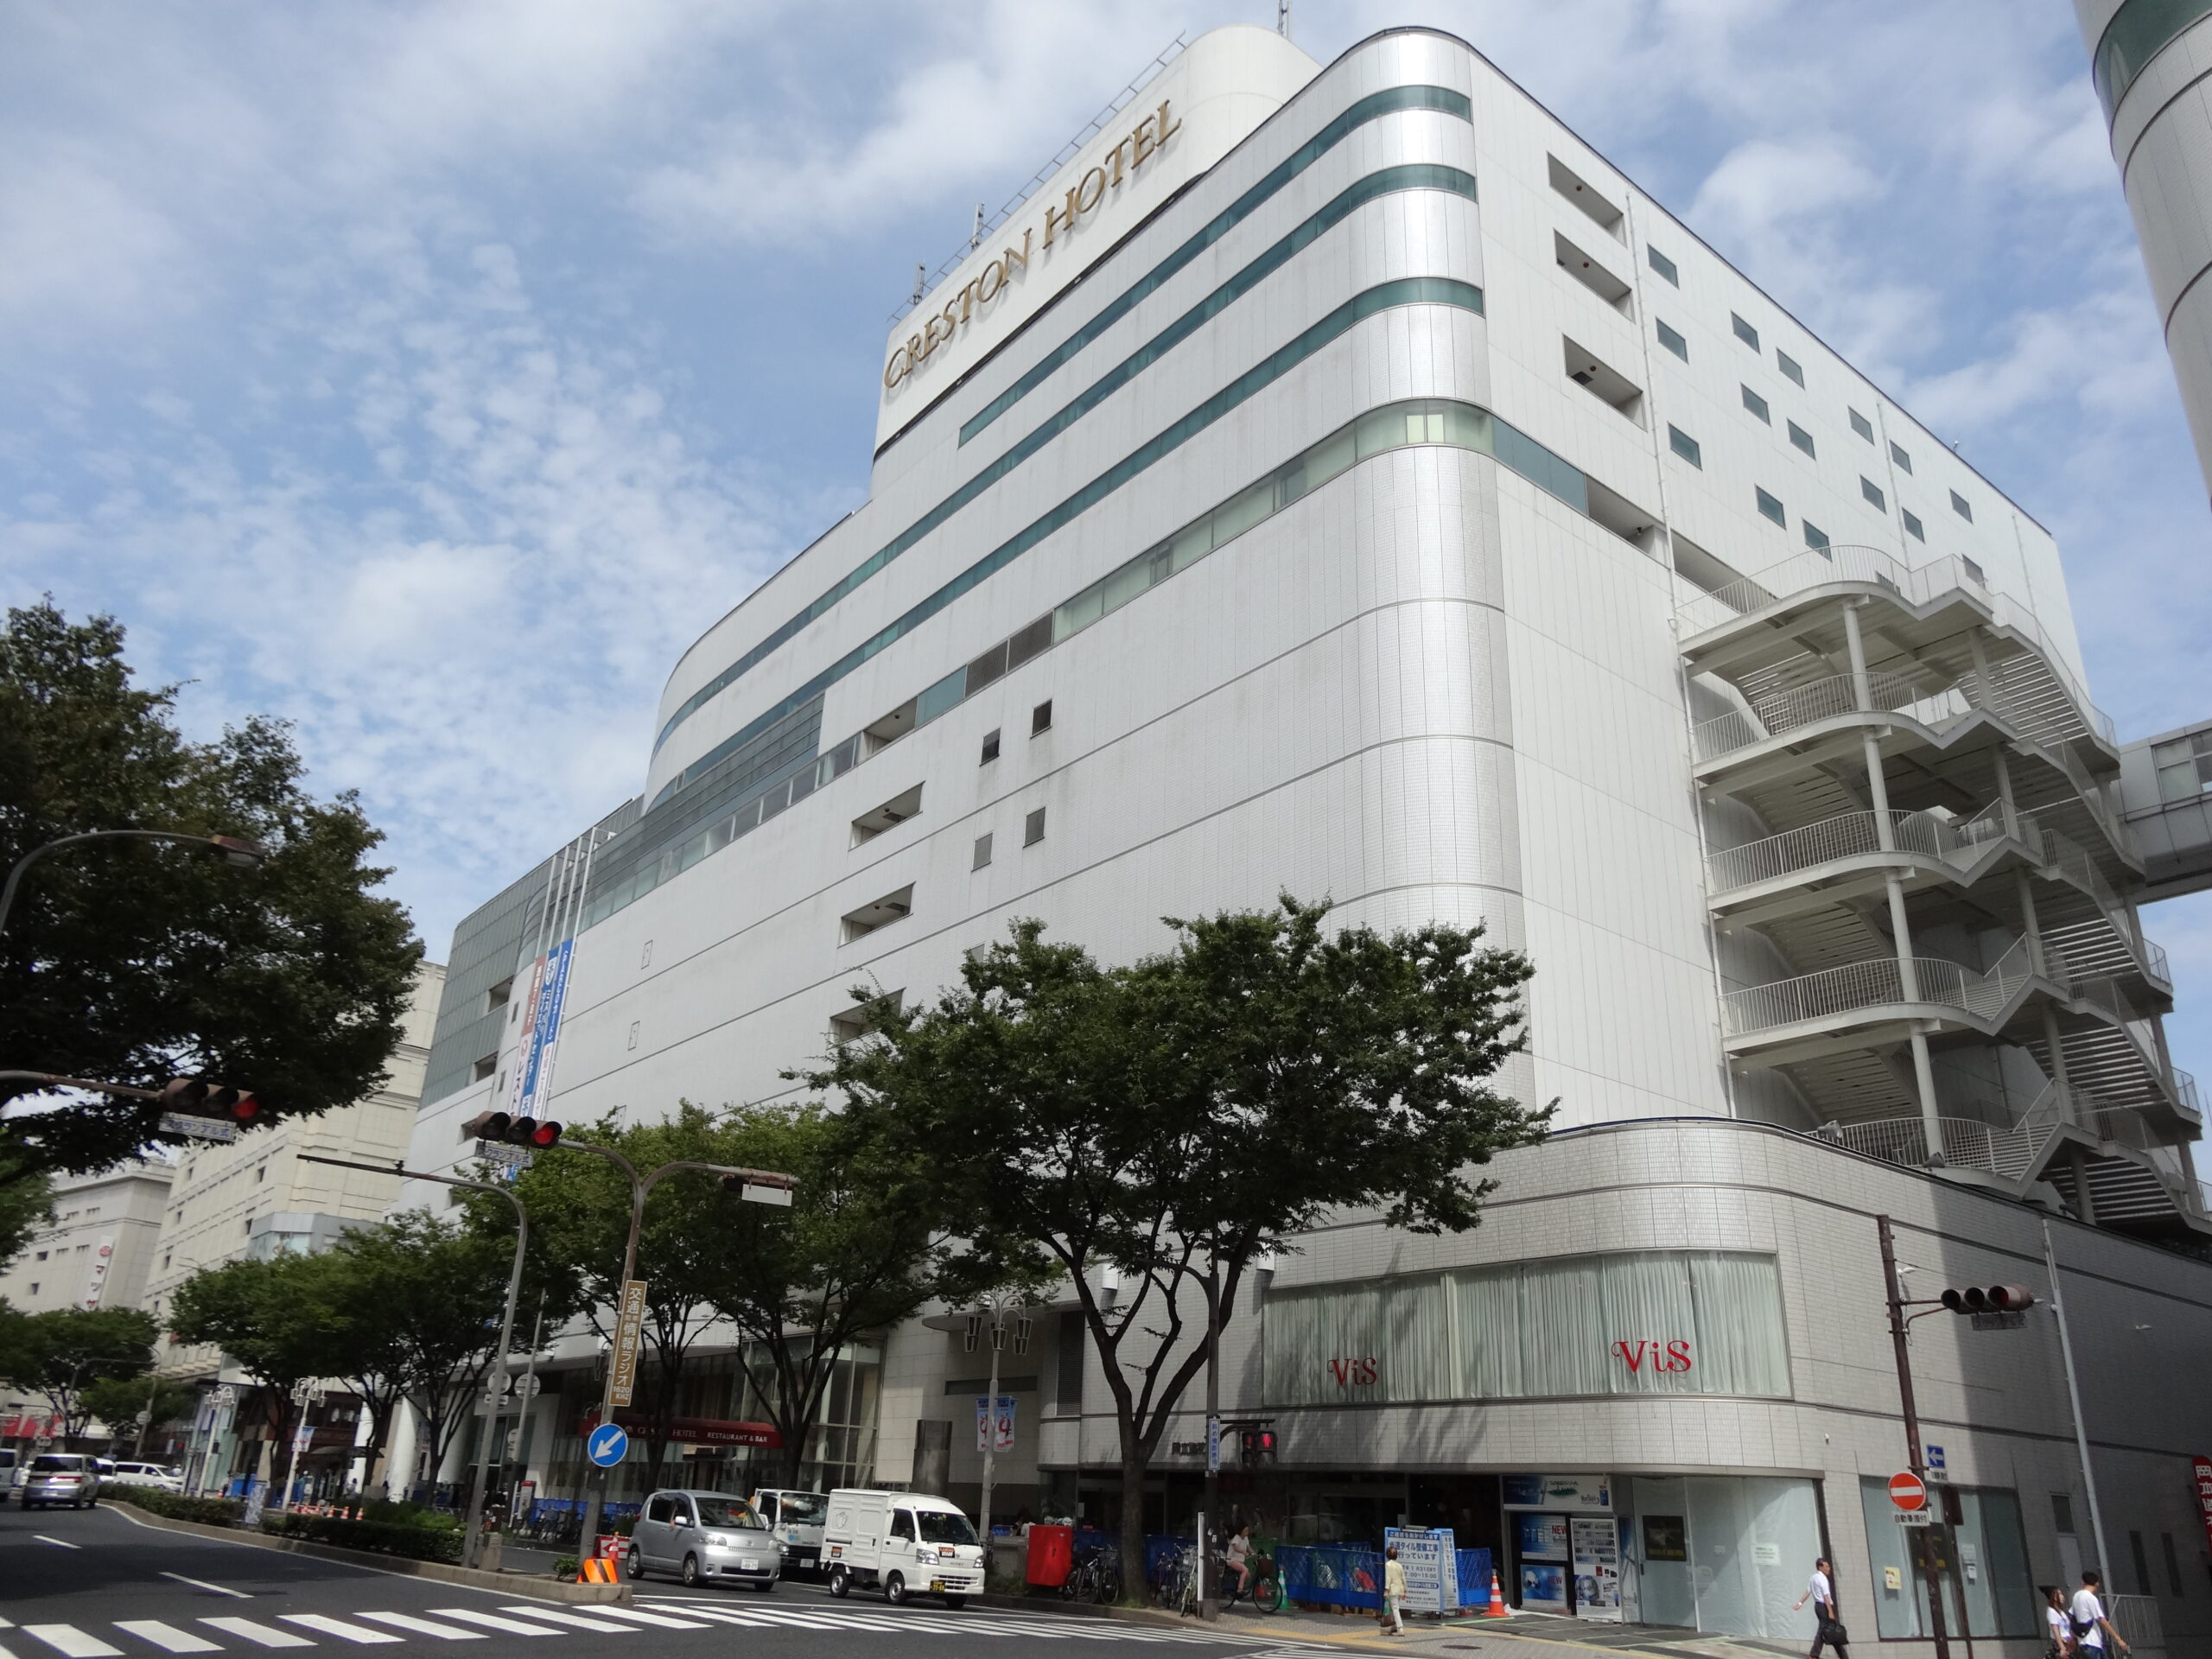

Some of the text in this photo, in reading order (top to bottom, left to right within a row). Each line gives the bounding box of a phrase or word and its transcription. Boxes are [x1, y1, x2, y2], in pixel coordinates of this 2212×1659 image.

[884, 99, 1182, 388] CRESTON HOTEL
[1611, 1340, 1693, 1373] ViS
[1326, 1357, 1377, 1386] ViS
[672, 1429, 697, 1438] HOTEL
[707, 1432, 747, 1441] RESTAURANT
[1552, 1525, 1568, 1535] NEW
